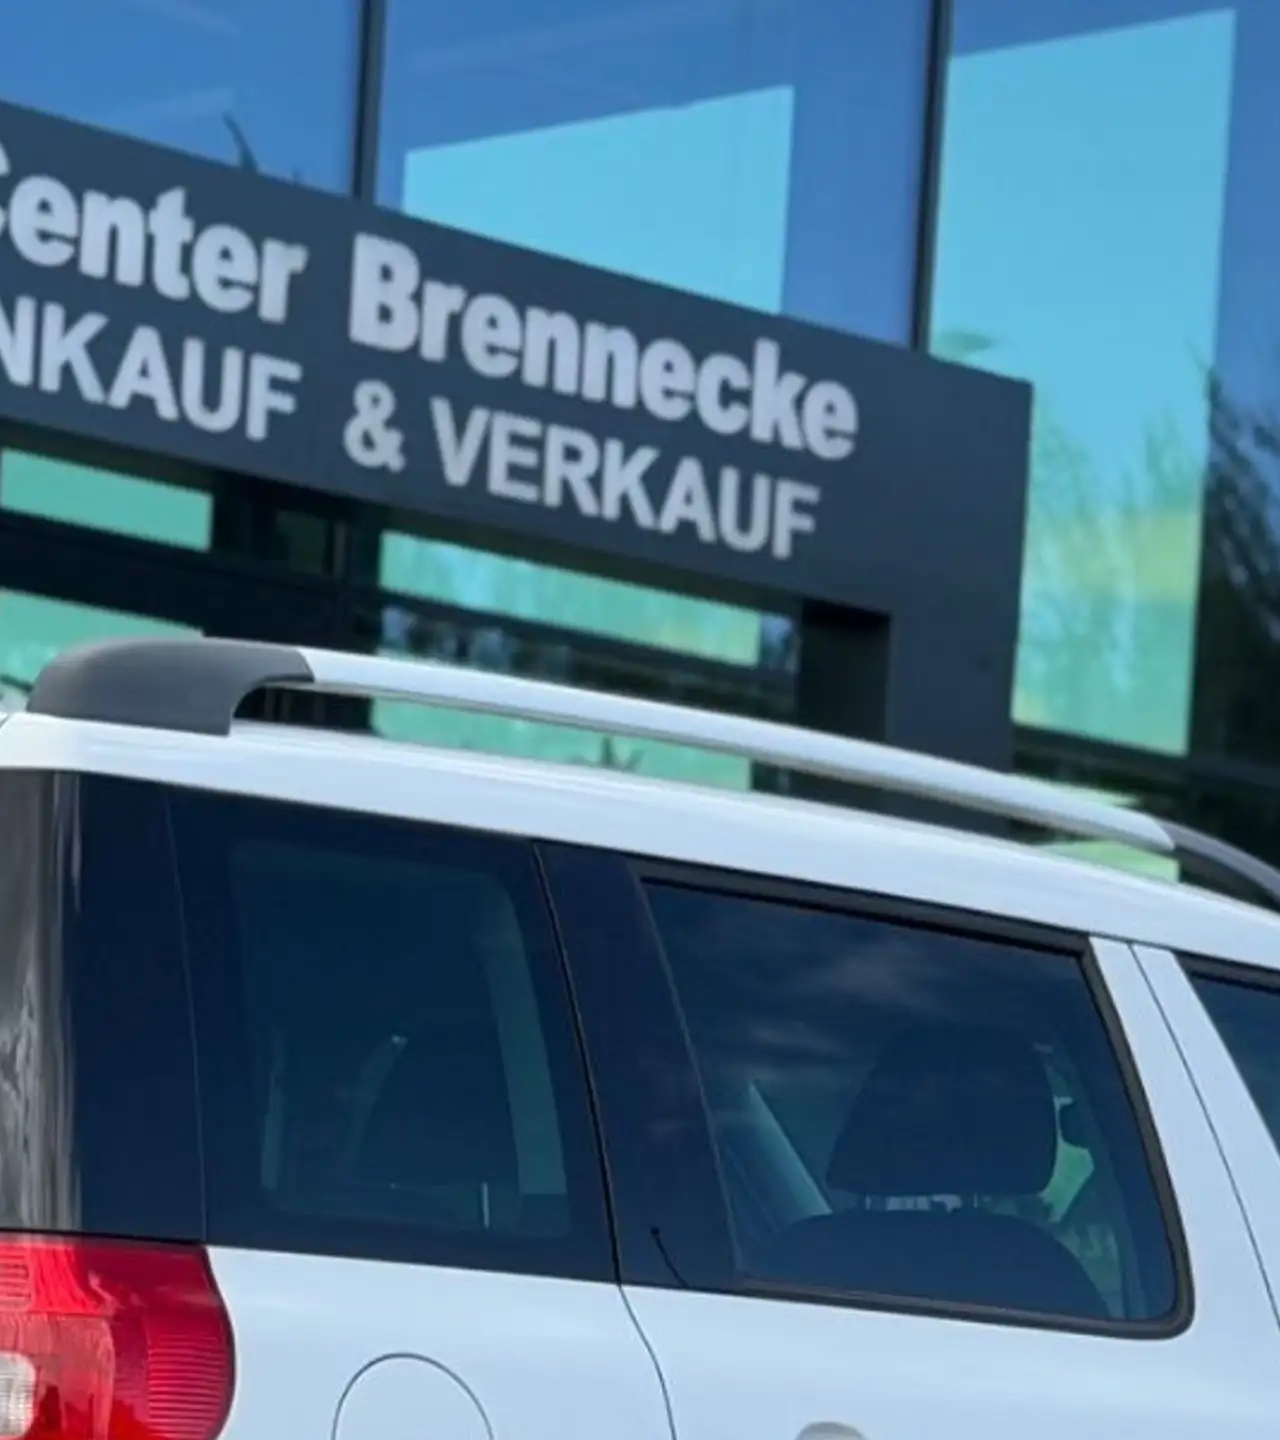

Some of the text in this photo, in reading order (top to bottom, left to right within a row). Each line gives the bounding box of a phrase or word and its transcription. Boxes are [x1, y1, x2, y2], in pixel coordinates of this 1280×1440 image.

[349, 233, 859, 460] Brennecke
[343, 381, 405, 471] &
[431, 397, 820, 558] VERKAUF
